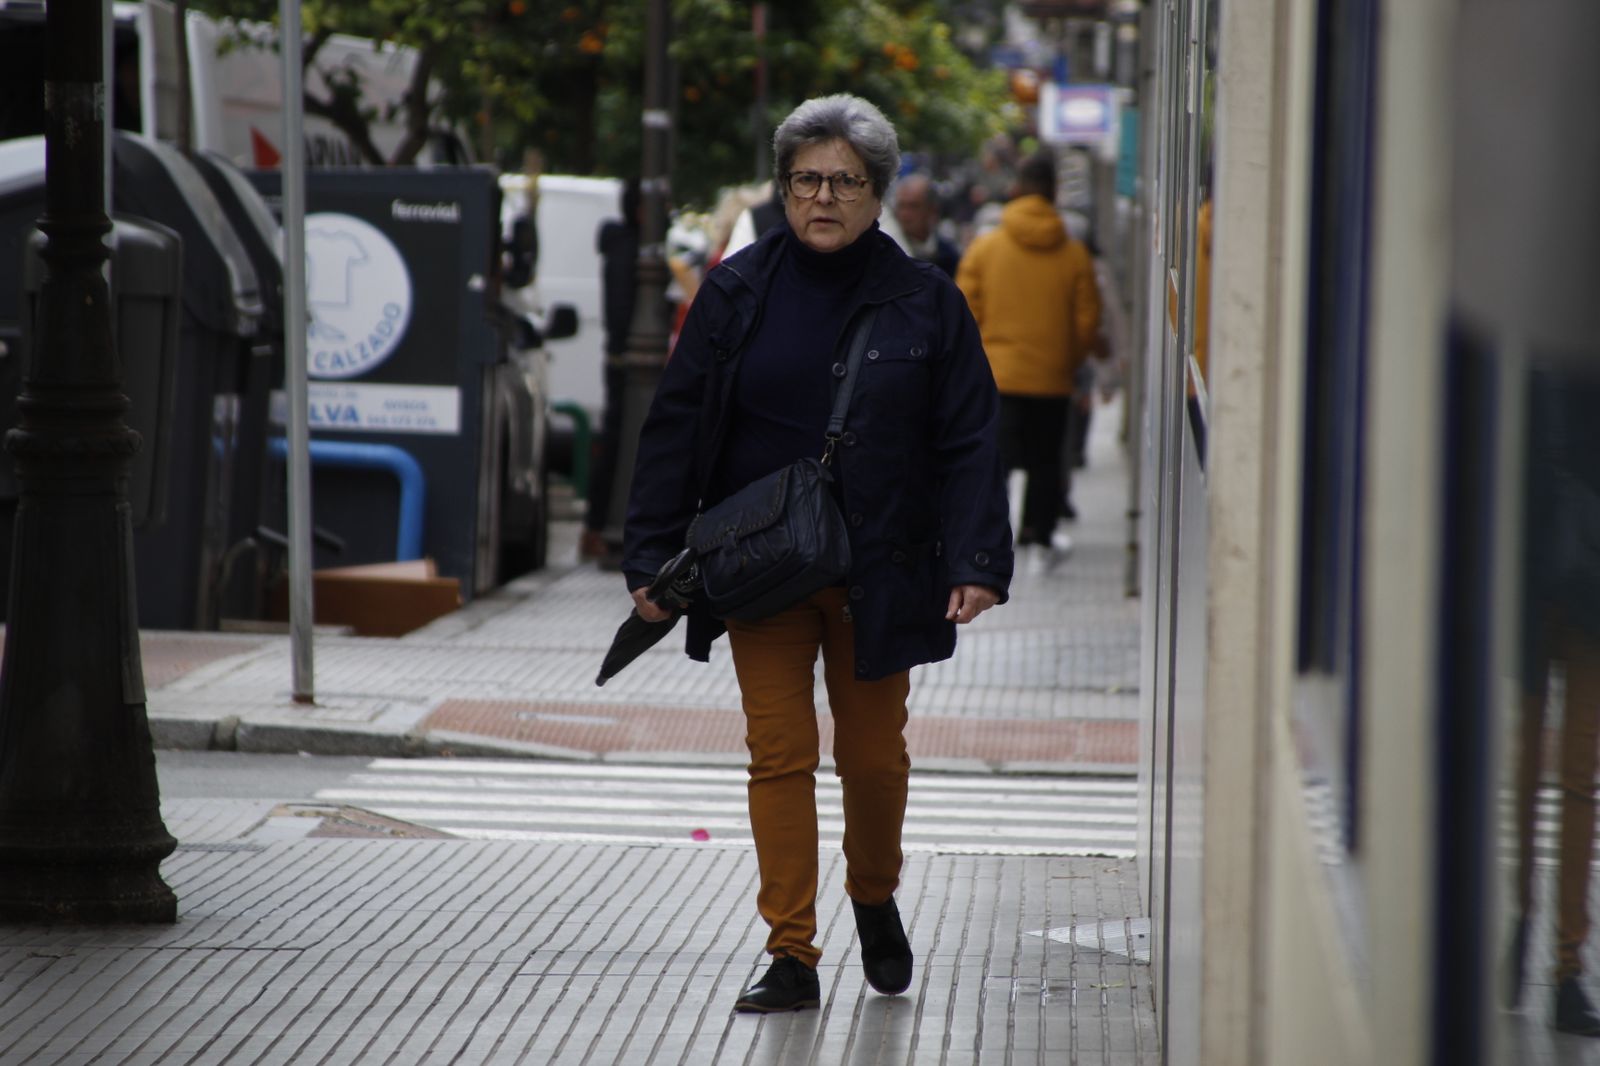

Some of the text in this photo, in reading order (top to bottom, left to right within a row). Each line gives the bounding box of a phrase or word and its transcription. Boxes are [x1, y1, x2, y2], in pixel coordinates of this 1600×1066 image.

[391, 198, 460, 222] ferrovial
[314, 302, 402, 370] CALZADO
[309, 403, 359, 424] LVA
